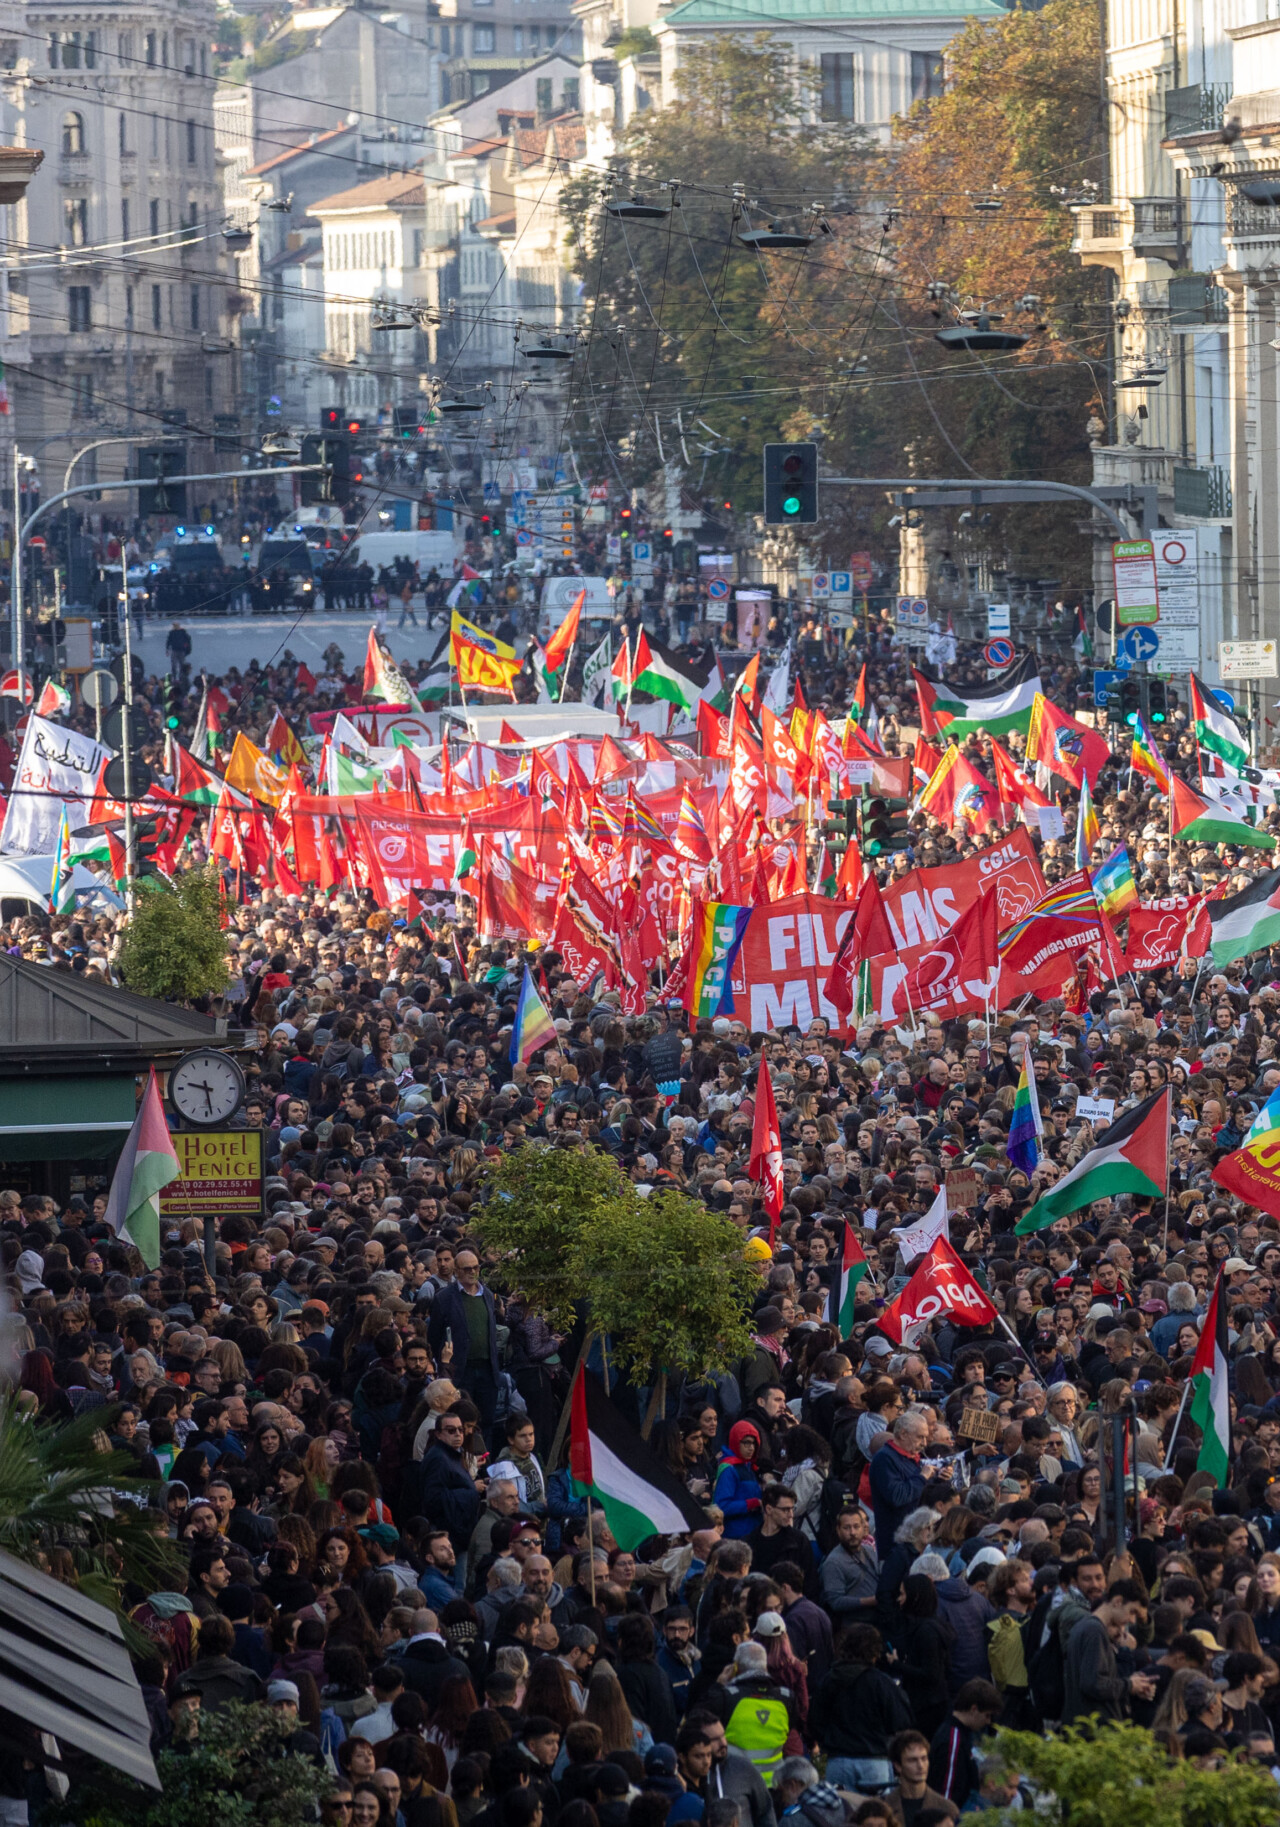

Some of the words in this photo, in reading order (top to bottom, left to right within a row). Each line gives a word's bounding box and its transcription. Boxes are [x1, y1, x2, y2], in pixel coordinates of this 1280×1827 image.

[1117, 543, 1149, 555] AreaC
[978, 844, 1020, 875] CGIL
[701, 925, 736, 999] PACE
[192, 1180, 252, 1188] 02.29.52.55.41
[171, 1190, 247, 1198] www.hotelfenice.it
